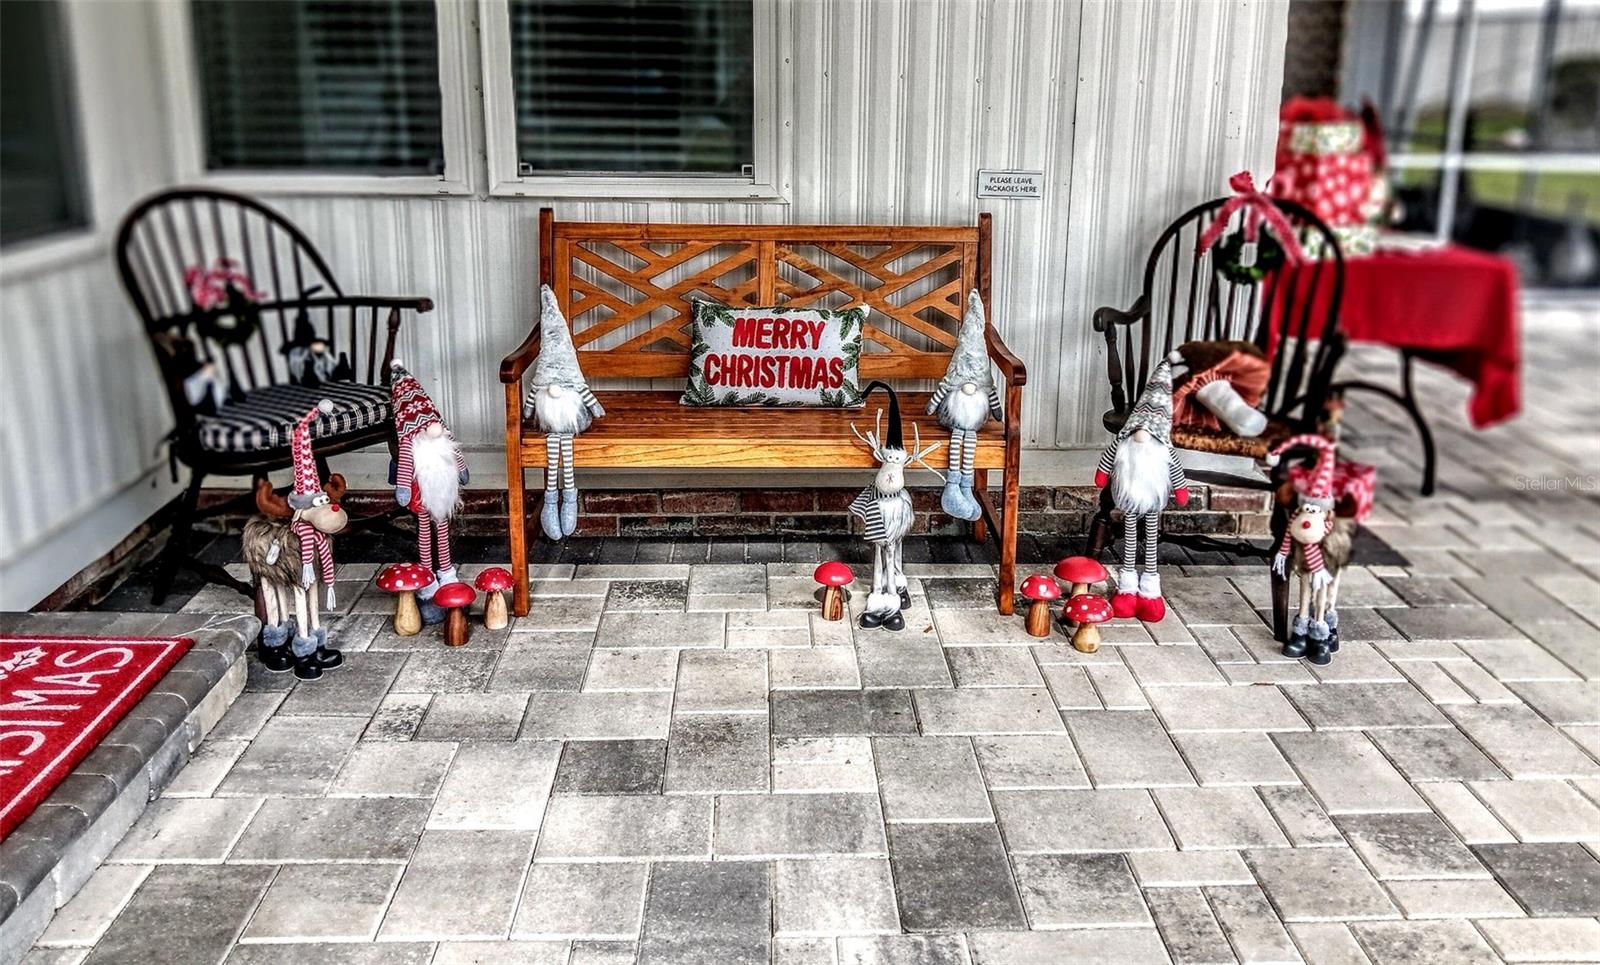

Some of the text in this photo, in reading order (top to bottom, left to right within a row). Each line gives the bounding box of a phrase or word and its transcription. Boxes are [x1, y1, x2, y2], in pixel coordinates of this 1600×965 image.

[984, 185, 1019, 193] PACKAGES
[990, 176, 1033, 185] PLEASE LEAVE
[732, 318, 825, 350] MERRY
[704, 354, 844, 389] CHRISTMAS
